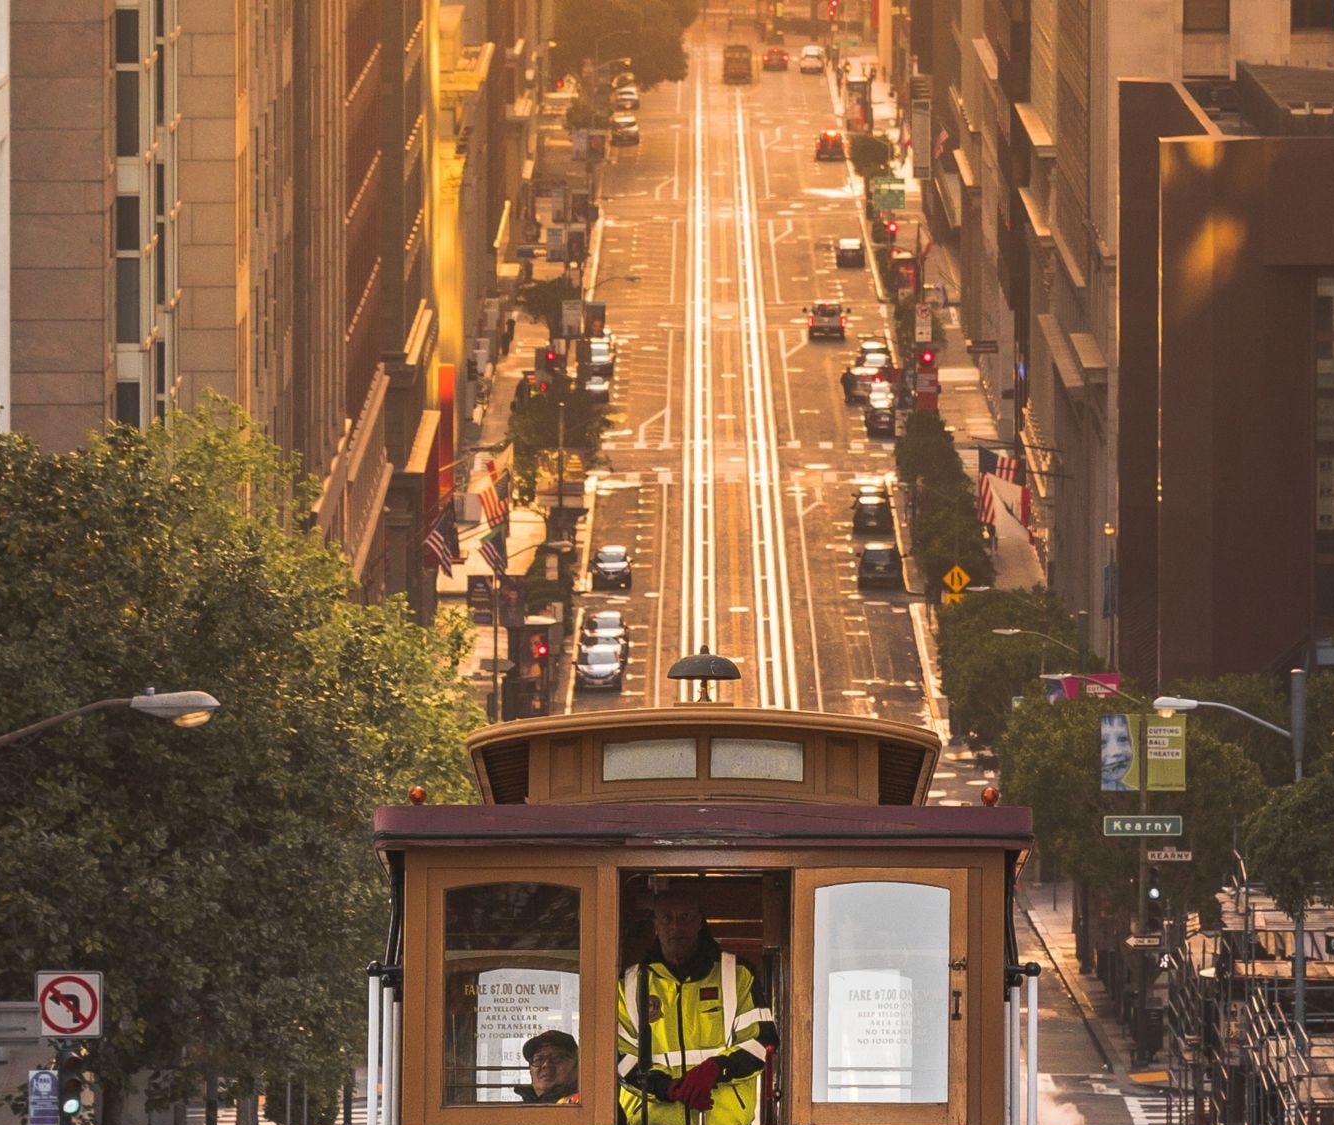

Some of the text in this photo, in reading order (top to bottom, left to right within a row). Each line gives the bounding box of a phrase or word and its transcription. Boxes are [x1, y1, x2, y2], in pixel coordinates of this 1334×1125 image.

[1148, 727, 1180, 735] CUTTING
[1113, 821, 1172, 833] Kearny
[464, 983, 560, 996] FARE $7.00 ONE WAY
[848, 989, 872, 1001] FARE
[874, 989, 897, 1001] $7.00
